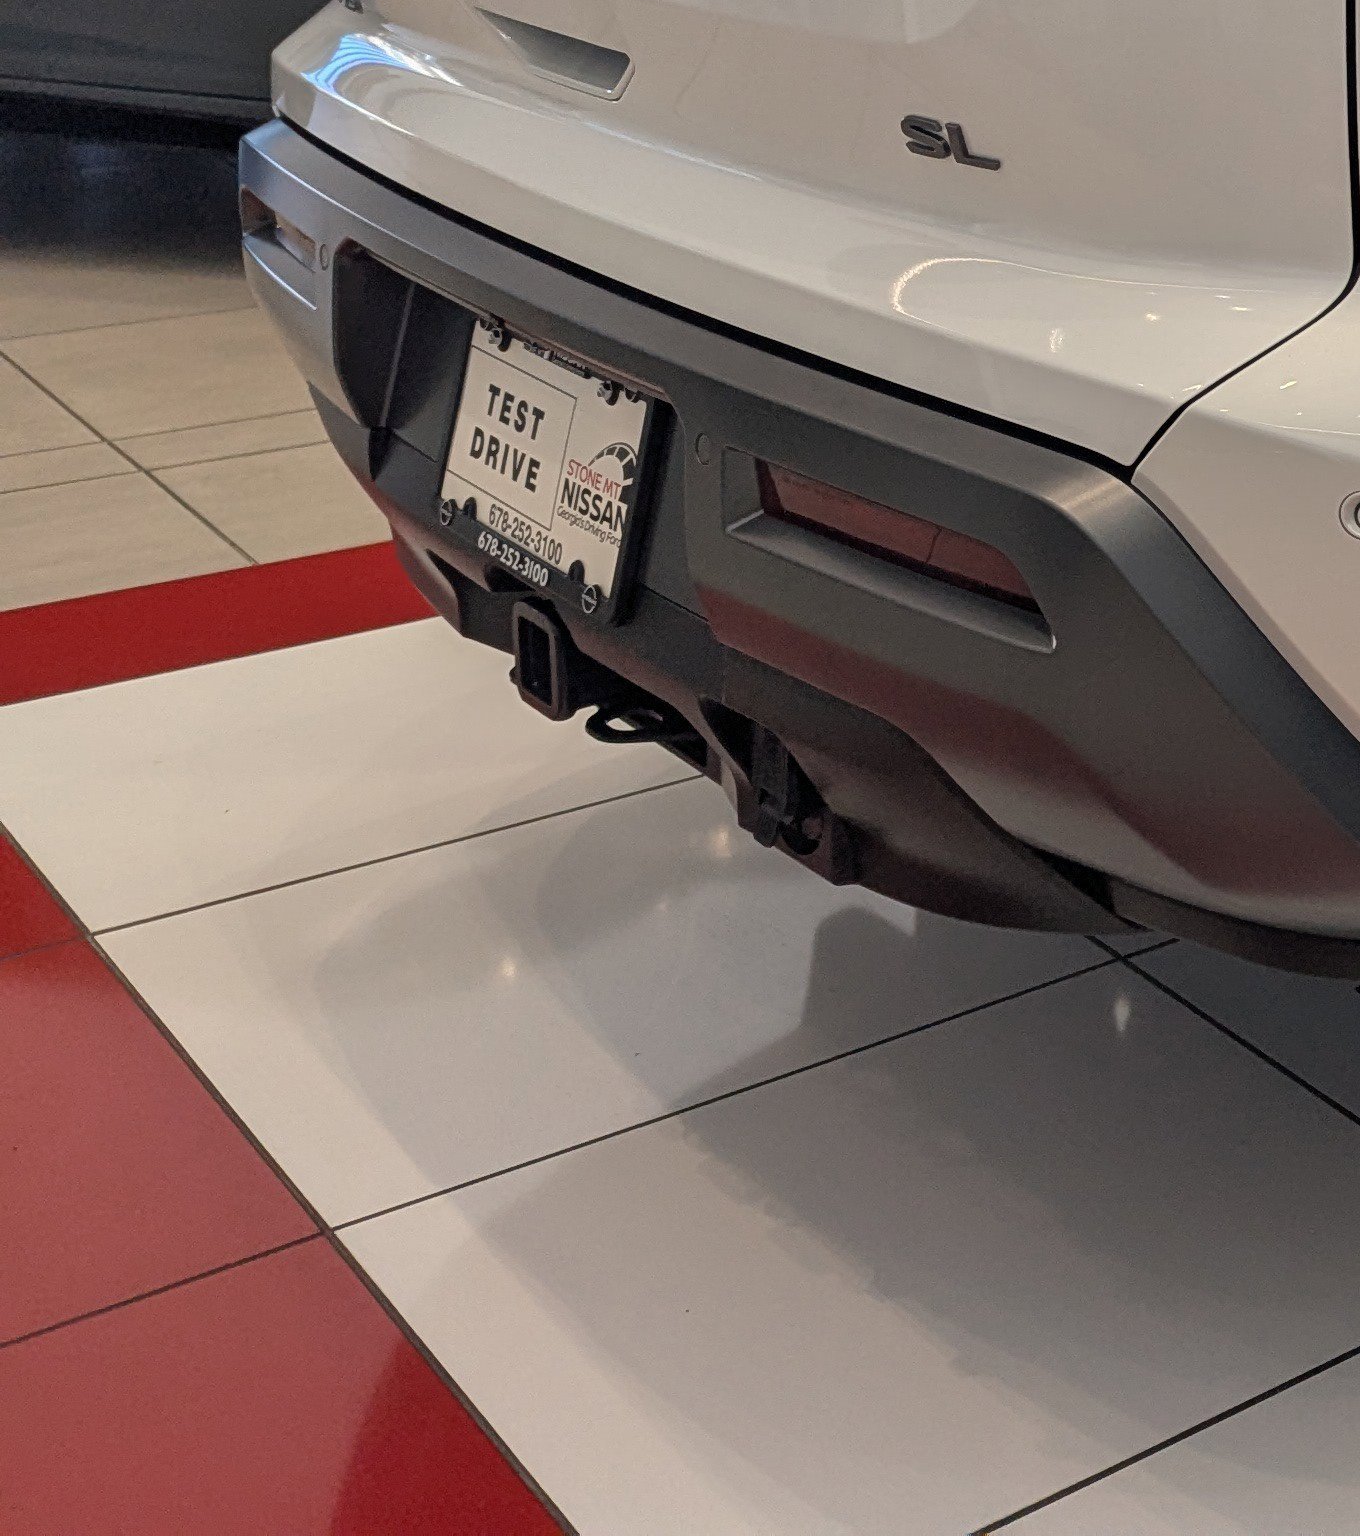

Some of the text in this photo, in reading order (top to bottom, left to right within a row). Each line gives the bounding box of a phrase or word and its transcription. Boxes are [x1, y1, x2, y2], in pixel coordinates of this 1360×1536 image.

[900, 112, 1002, 172] SL
[487, 383, 546, 441] TEST
[469, 425, 541, 494] DRIVE
[566, 458, 622, 501] STONE MT
[560, 477, 628, 532] NISSAN
[477, 530, 549, 587] 678-252-3100
[489, 503, 563, 565] 678-252-3100
